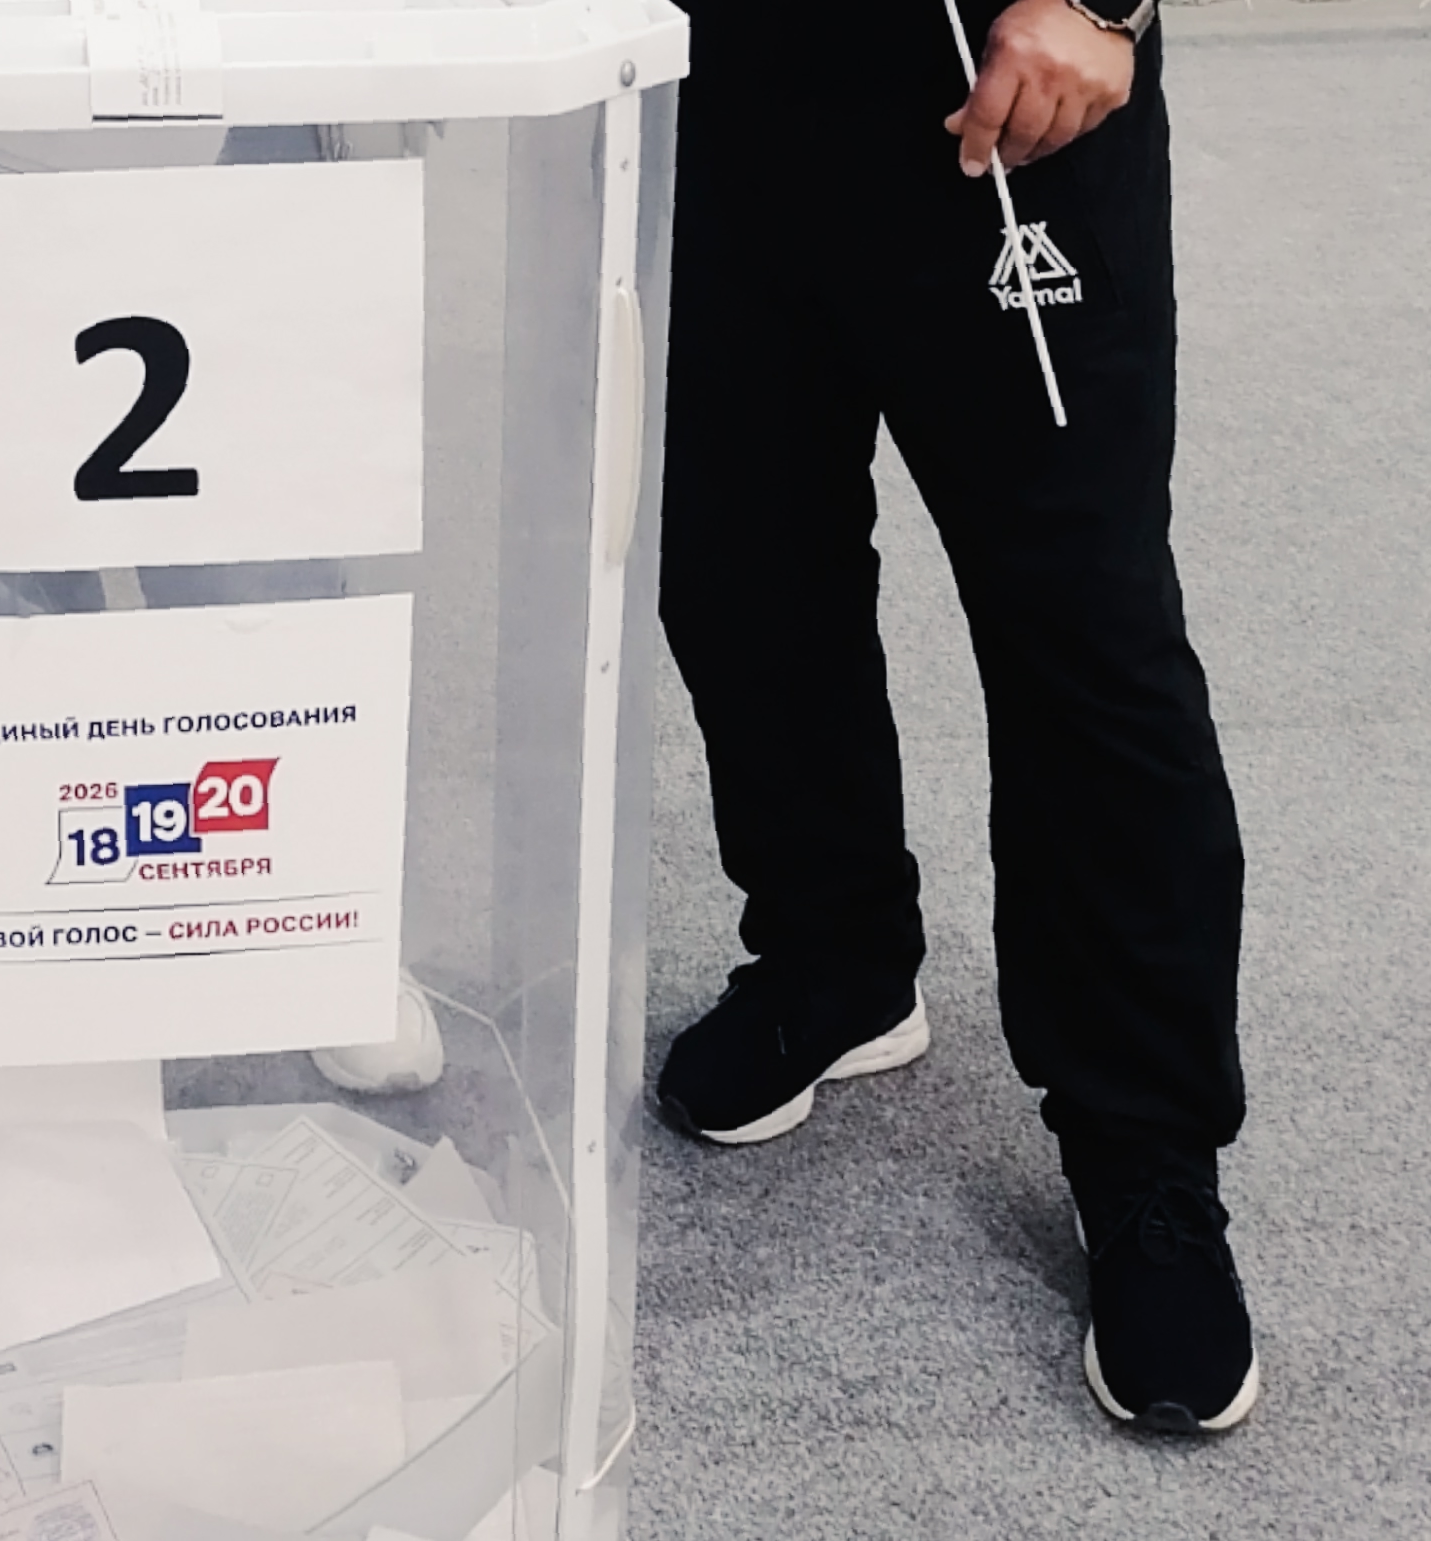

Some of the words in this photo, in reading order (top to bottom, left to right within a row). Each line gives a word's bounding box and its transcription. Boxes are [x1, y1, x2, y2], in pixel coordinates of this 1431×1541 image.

[988, 277, 1083, 311] Yamal
[73, 315, 199, 502] 2
[89, 718, 155, 739] ДЕНЬ
[164, 706, 355, 733] ГОЛОСОВАНИЯ
[60, 783, 117, 800] 2026
[68, 828, 120, 865] 18
[131, 799, 188, 842] 19
[197, 774, 264, 819] 20
[139, 858, 270, 879] СЕНТЯБРЯ
[54, 926, 136, 945] ГОЛОС
[169, 921, 238, 939] СИЛА
[247, 912, 357, 934] РОССИИ!
